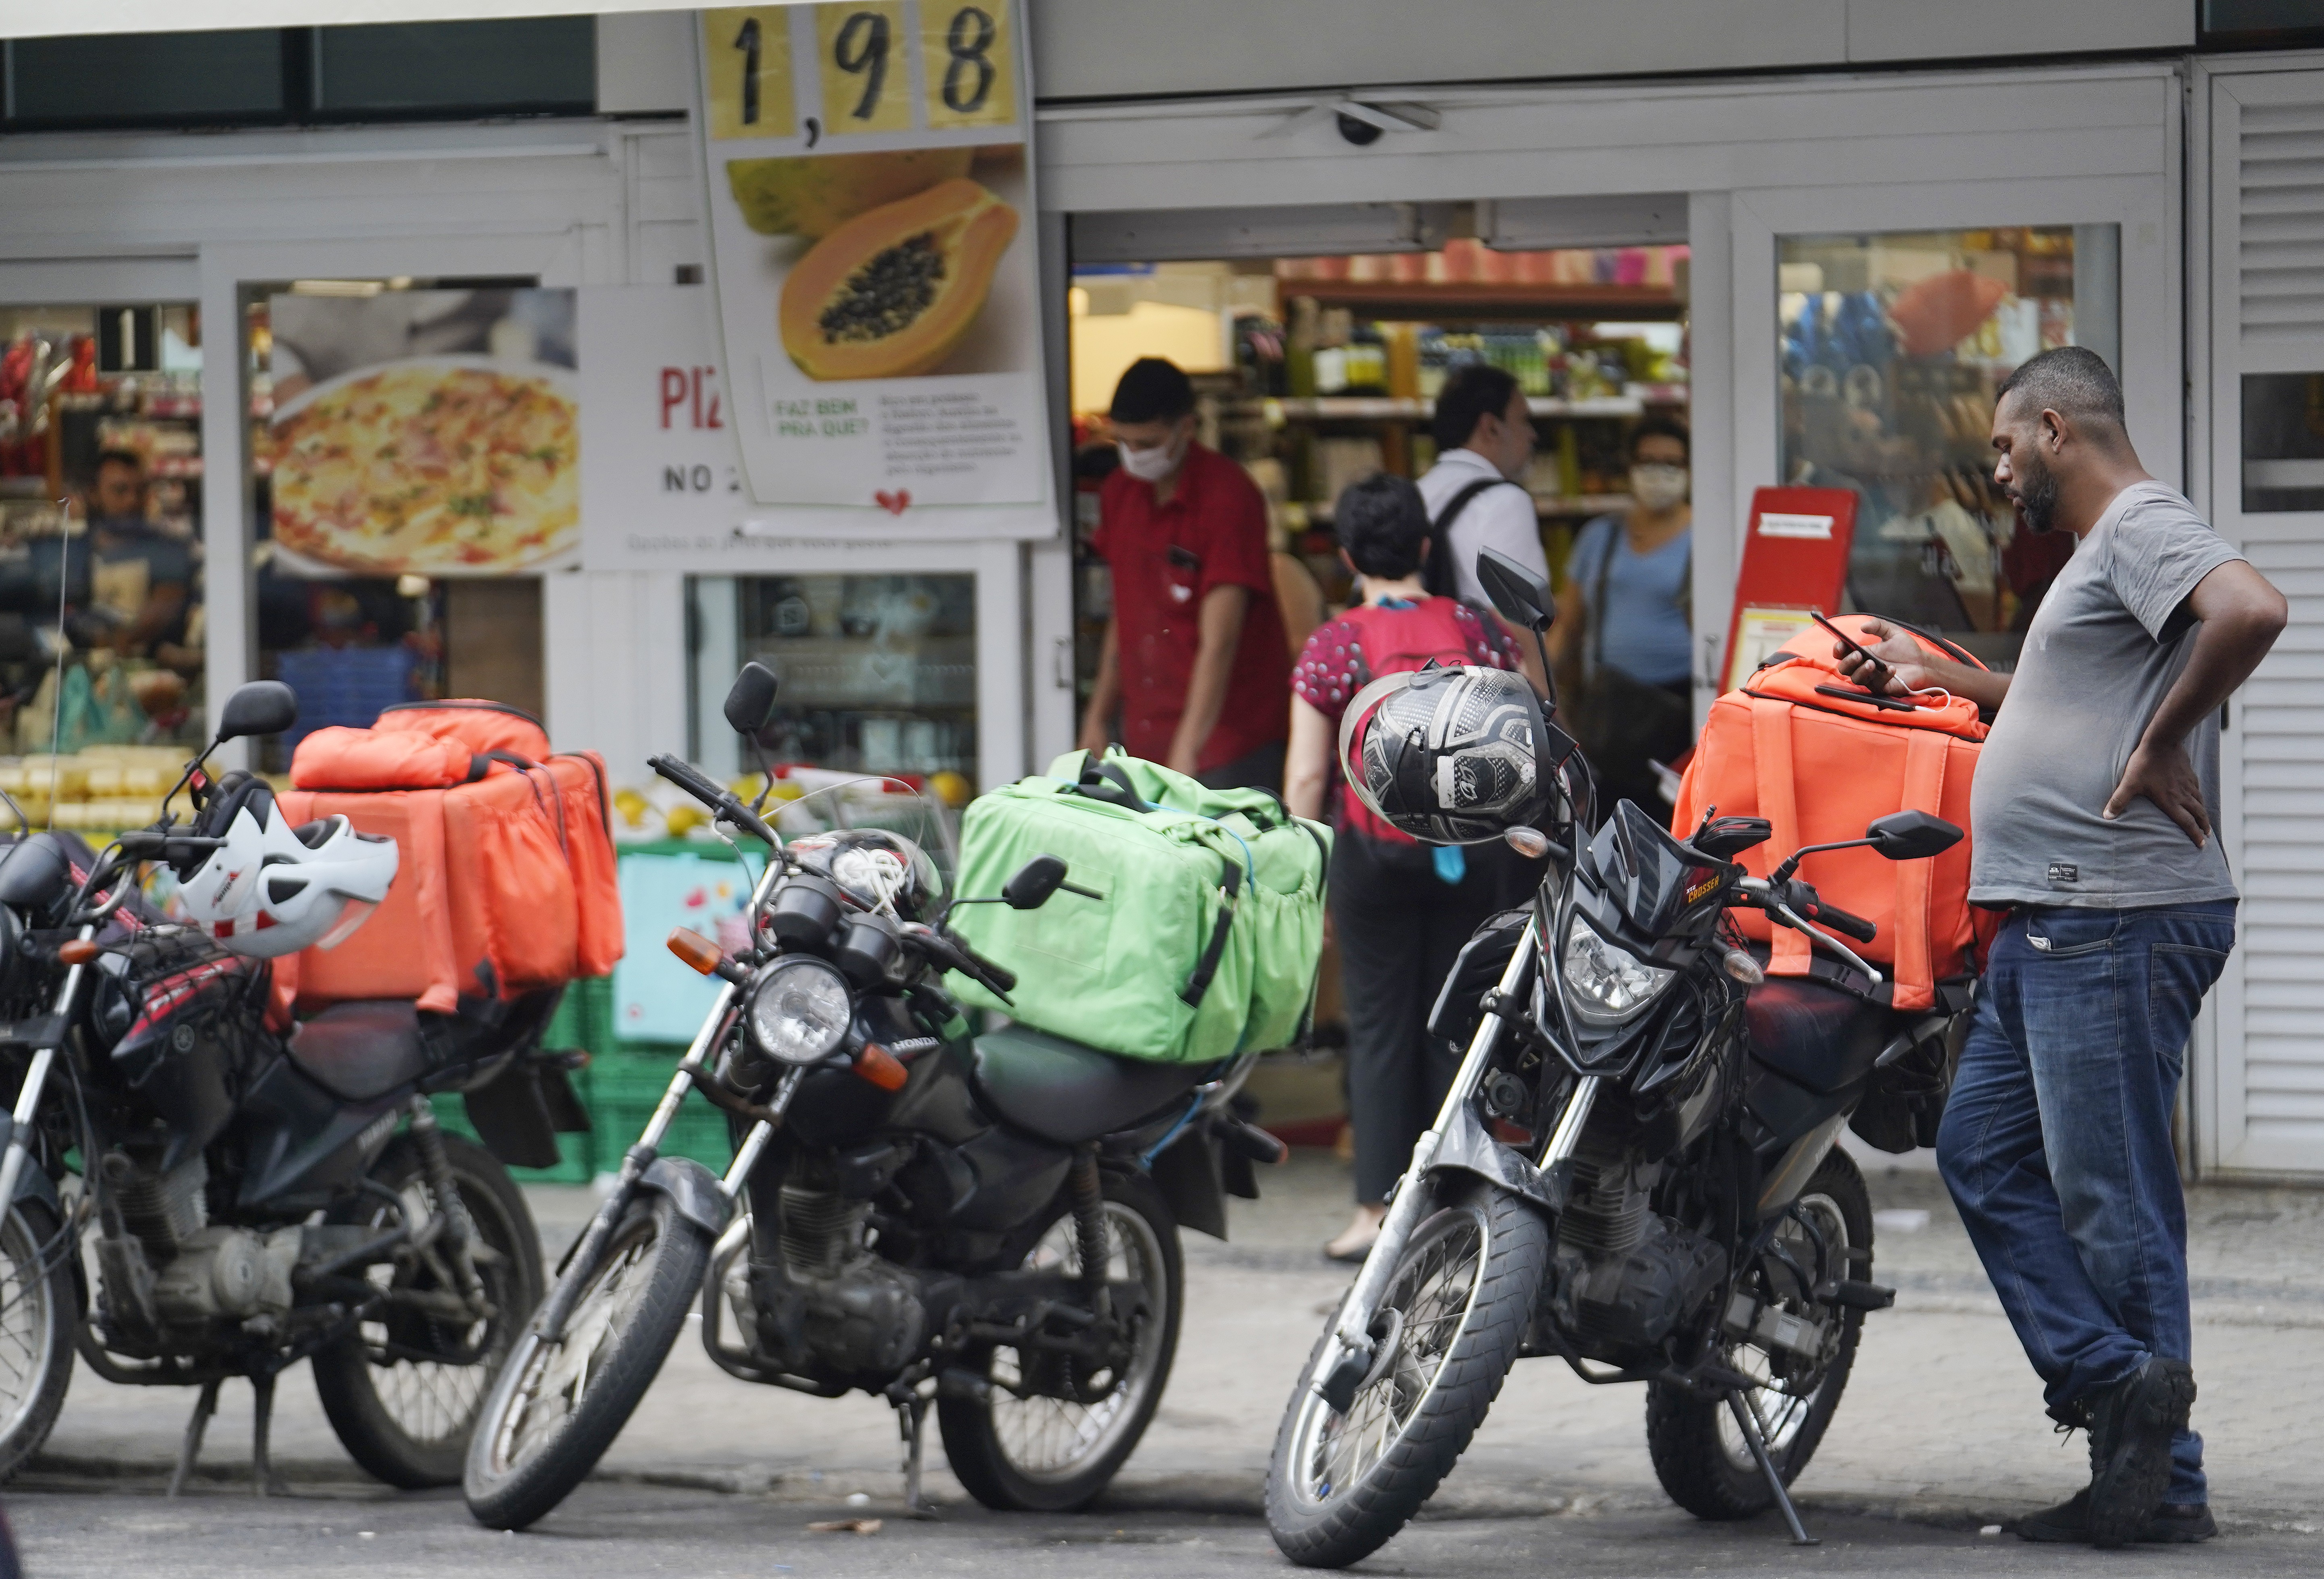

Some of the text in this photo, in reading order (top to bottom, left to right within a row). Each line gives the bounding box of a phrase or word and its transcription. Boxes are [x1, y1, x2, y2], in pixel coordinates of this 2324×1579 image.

[735, 6, 996, 149] 1,98
[663, 464, 712, 491] NO
[1686, 884, 1696, 894] XTZ
[1688, 874, 1719, 903] CROSSER
[891, 1036, 941, 1050] HONDA
